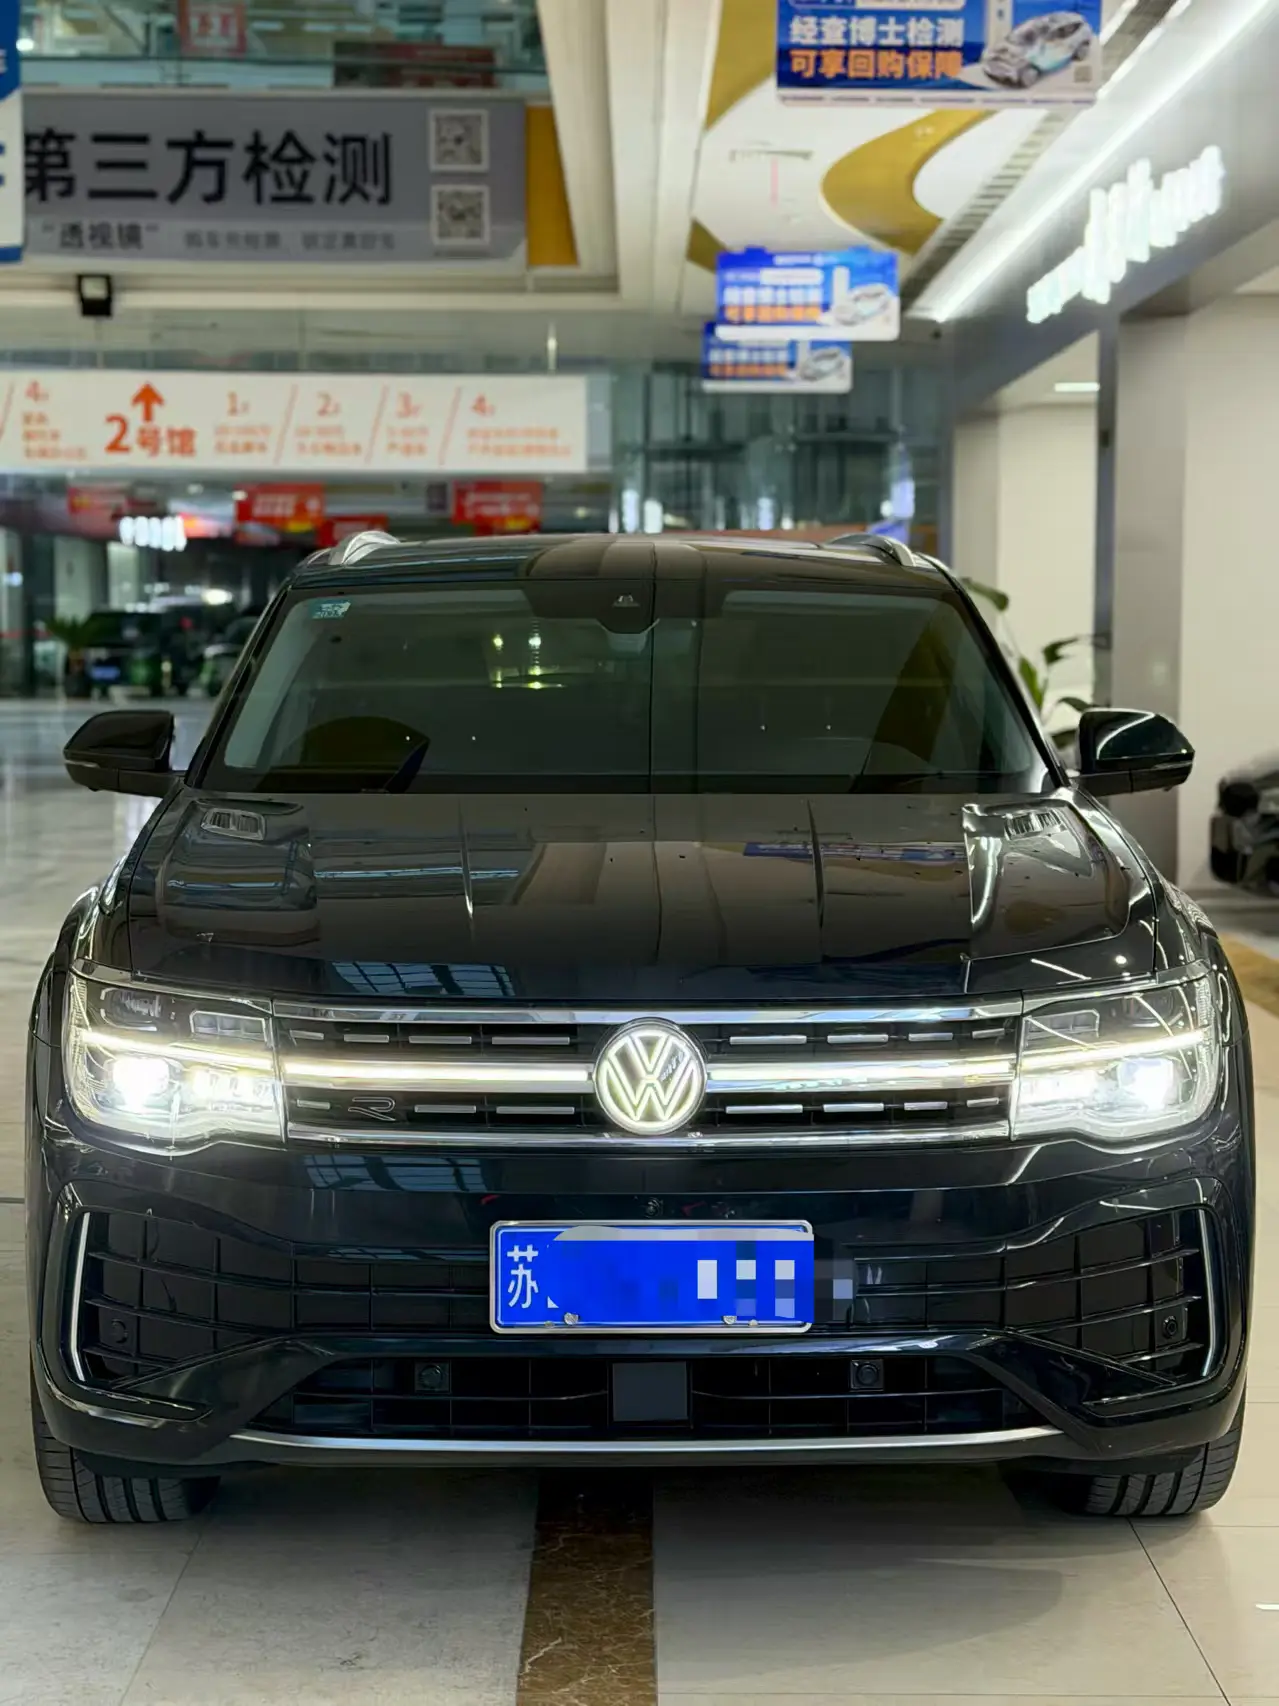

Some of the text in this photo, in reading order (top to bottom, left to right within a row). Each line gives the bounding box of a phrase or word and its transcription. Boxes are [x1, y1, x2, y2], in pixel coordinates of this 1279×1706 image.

[789, 14, 966, 48] 经查博士检测
[788, 48, 965, 80] 可享回购保障
[23, 128, 394, 207] 第三方检测
[104, 413, 197, 457] 2号馆
